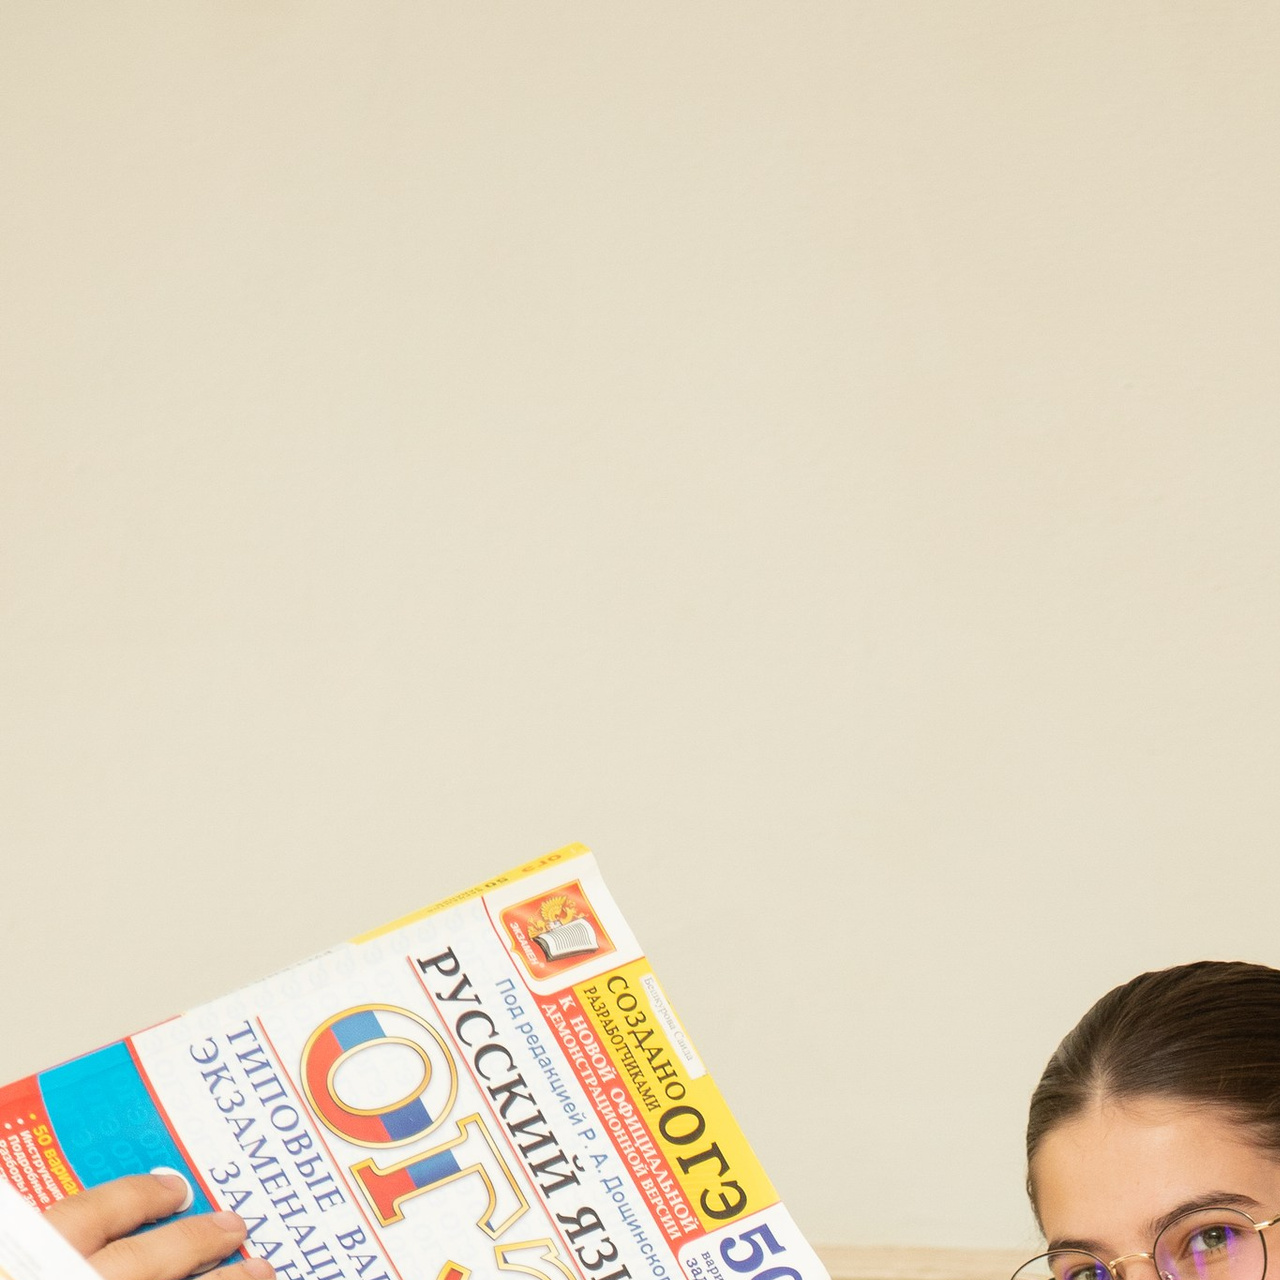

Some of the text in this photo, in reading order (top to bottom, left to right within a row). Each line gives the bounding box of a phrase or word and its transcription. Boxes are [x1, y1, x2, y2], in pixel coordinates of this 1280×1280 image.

[226, 1020, 346, 1212] ТИПОВЫЕ
[416, 945, 586, 1199] РУССКИЙ
[495, 977, 524, 1019] Под
[514, 1021, 586, 1127] редакцией
[541, 1003, 683, 1241] ДЕМОНСТРАЦИОННОЙ ВЕРСИИ
[558, 995, 699, 1233] К НОВОЙ ОФИЦИАЛЬНОЙ
[584, 986, 748, 1220] РАЗРАБОТЧИКАМИ ОГЭ
[607, 975, 686, 1101] СОЗДАНО
[7, 1134, 50, 1204] Подробные
[32, 1124, 52, 1146] 50
